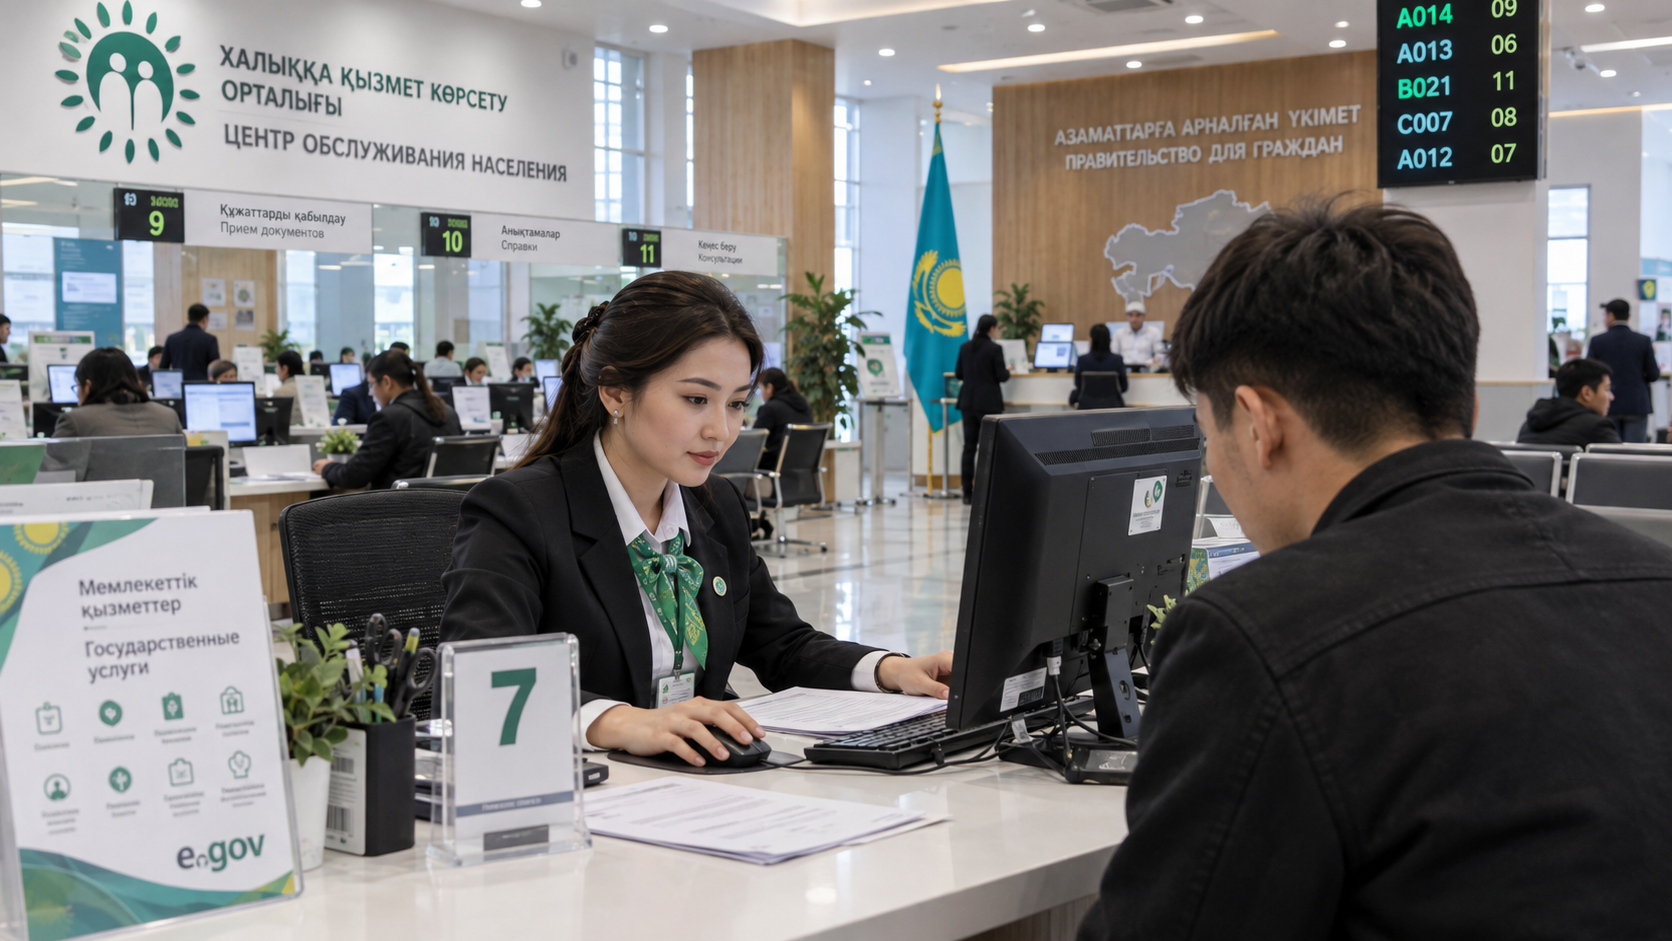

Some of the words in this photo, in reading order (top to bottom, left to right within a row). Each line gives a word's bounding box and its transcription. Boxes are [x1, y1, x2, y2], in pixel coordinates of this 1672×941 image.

[1396, 3, 1453, 29] A014
[1491, 0, 1518, 18] 09
[1396, 39, 1453, 64] A013
[1491, 33, 1518, 55] 06
[219, 44, 333, 86] ХАЛЫҚҚА
[341, 66, 424, 99] ҚЫЗМЕТ
[431, 82, 508, 113] КӨРСЕТУ
[1398, 75, 1450, 99] B021
[1492, 70, 1515, 91] 11
[221, 79, 342, 117] ОРТАЛЫҒЫ
[1054, 120, 1176, 146] АЗАМАТТАРҒА
[1181, 111, 1279, 136] АРНАЛҒАН
[1288, 104, 1361, 128] ҮКІМЕТ
[1397, 111, 1453, 135] C007
[1491, 107, 1517, 127] 08
[224, 123, 295, 150] ЦЕНТР
[302, 133, 466, 170] ОБСЛУЖИВАНИЯ
[472, 154, 568, 182] НАСЕЛЕНИЯ
[1065, 145, 1202, 171] ПРАВИТЕЛЬСТВО
[1208, 142, 1247, 164] ДЛЯ
[1253, 135, 1343, 159] ГРАЖДАН
[1397, 147, 1453, 170] A012
[1491, 143, 1517, 163] 07
[149, 210, 165, 236] 9
[220, 221, 258, 236] Прием
[261, 226, 325, 239] документов
[294, 210, 346, 226] қабылдау
[442, 230, 463, 253] 10
[501, 225, 561, 241] Анықтамалар
[501, 240, 538, 252] Справки
[640, 243, 655, 264] 11
[78, 572, 198, 597] Мемлекеттік
[81, 598, 182, 621] қызметтер
[85, 631, 240, 659] Государственные
[88, 661, 150, 685] услуги
[491, 667, 537, 747] 7
